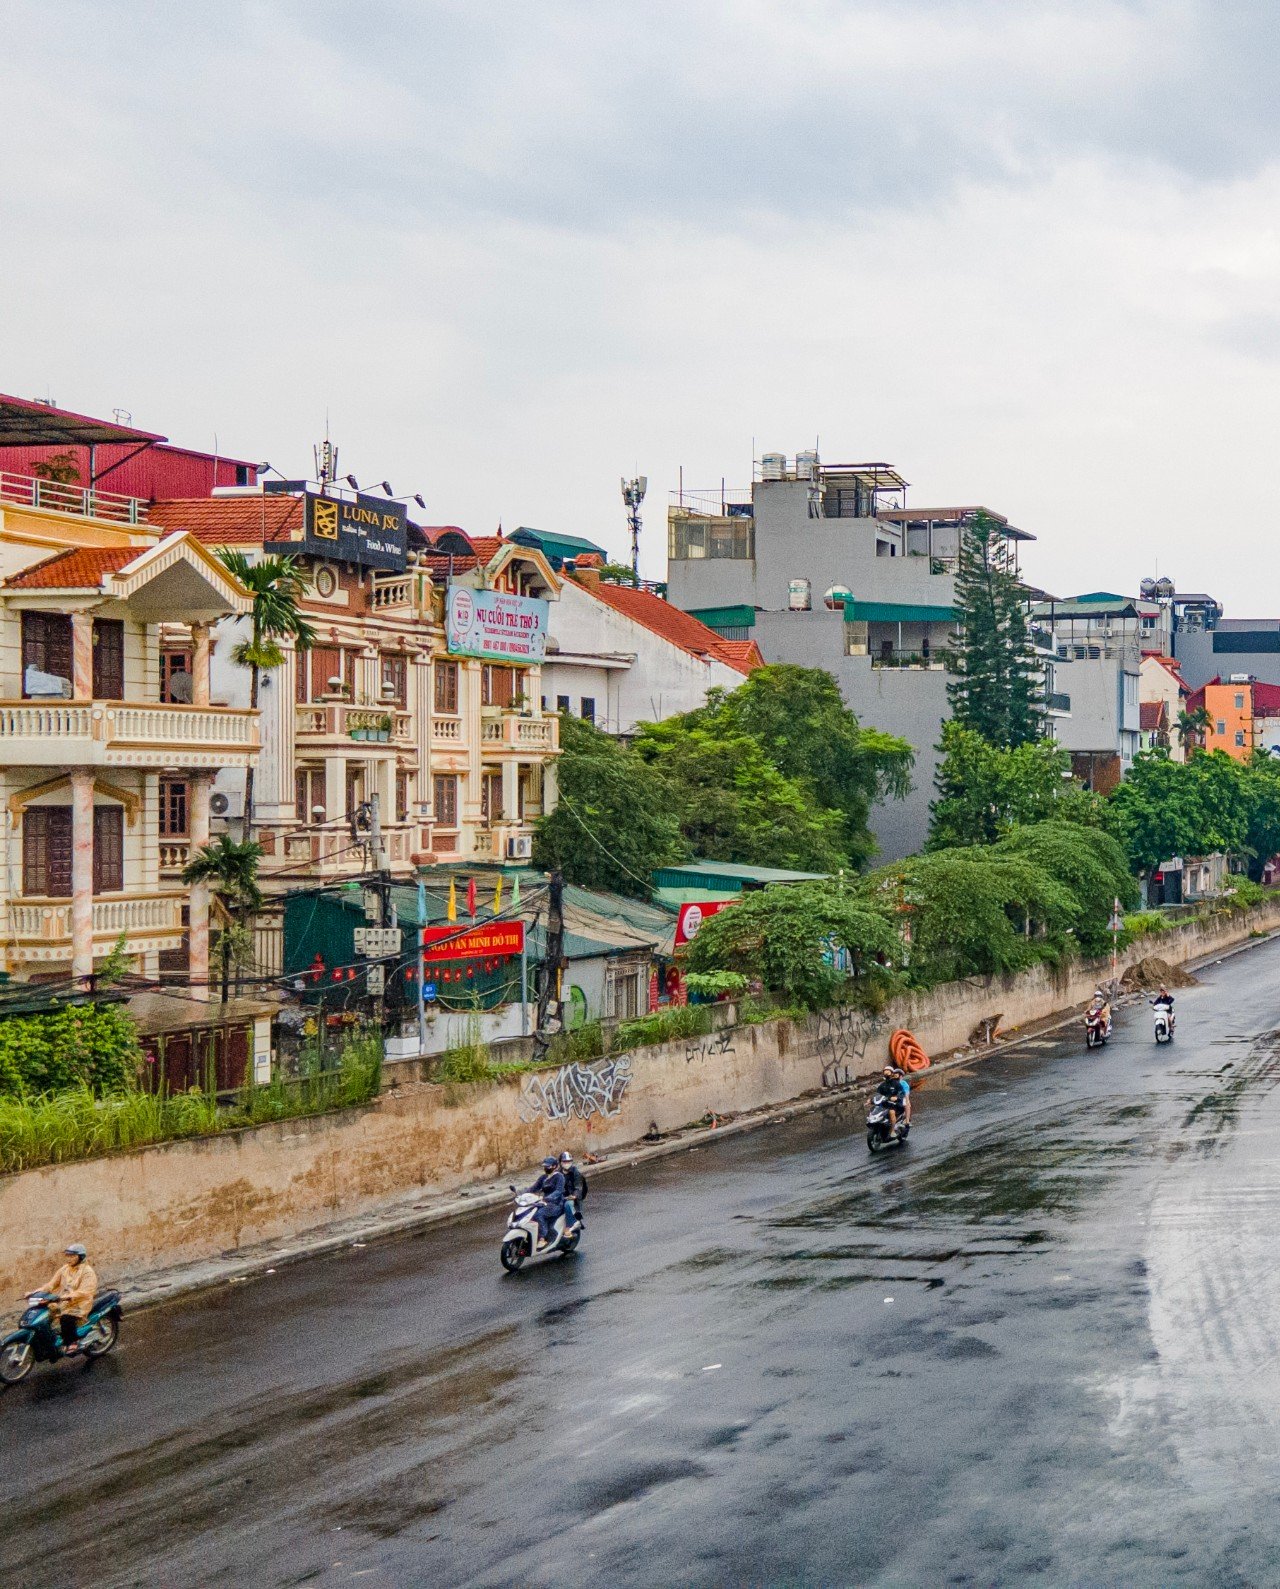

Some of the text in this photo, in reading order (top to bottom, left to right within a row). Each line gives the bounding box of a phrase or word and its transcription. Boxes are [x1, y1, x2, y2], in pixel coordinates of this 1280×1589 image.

[343, 505, 400, 531] LUNA JSC
[385, 542, 402, 555] Wine
[534, 615, 539, 629] 3
[468, 936, 490, 948] MINH
